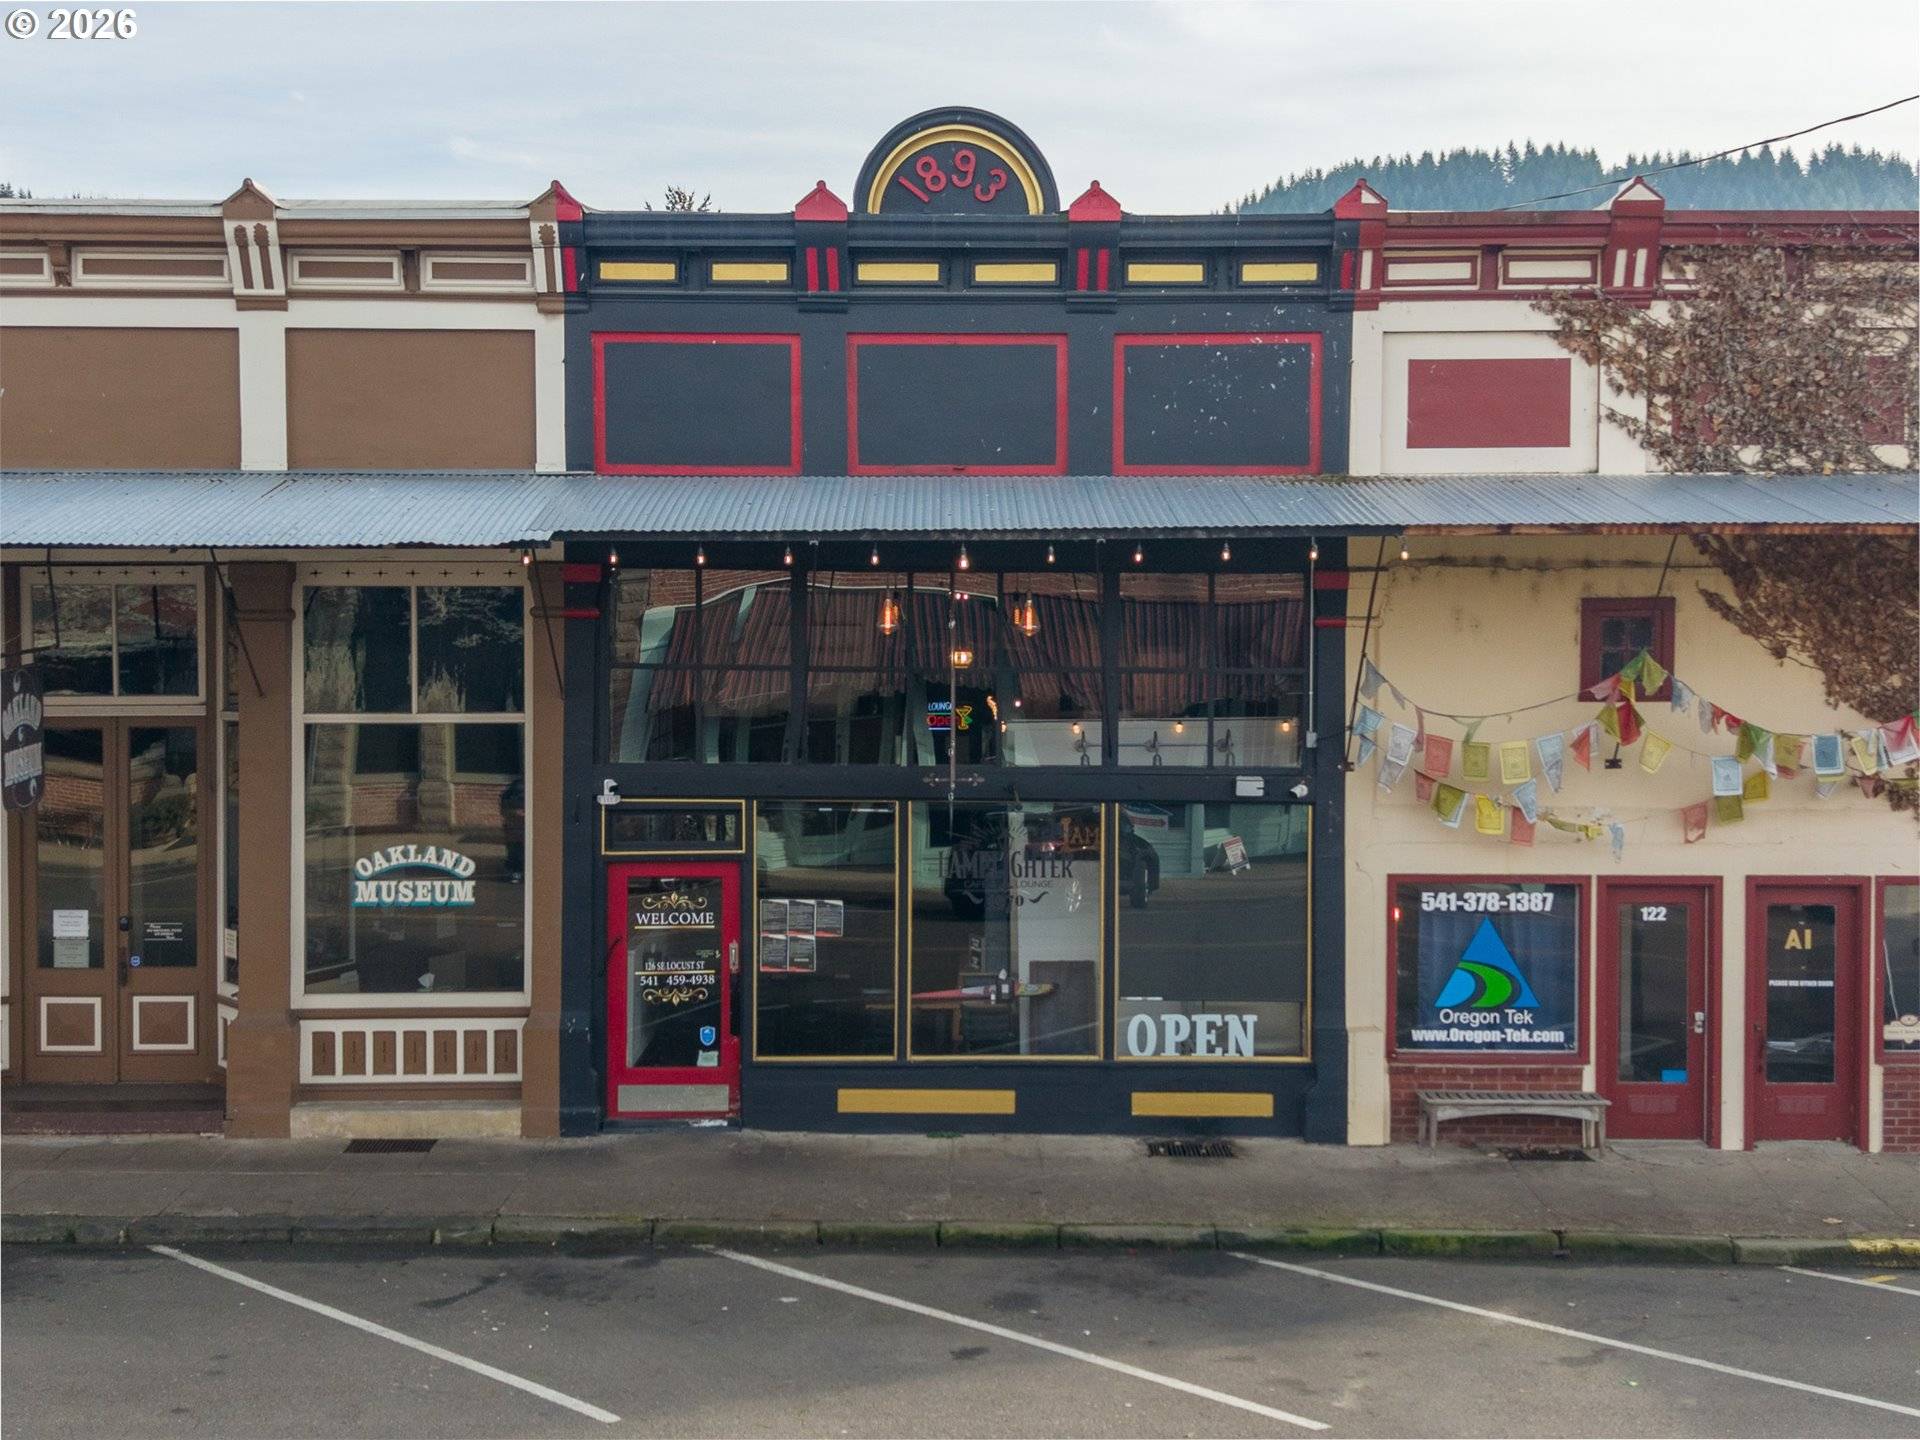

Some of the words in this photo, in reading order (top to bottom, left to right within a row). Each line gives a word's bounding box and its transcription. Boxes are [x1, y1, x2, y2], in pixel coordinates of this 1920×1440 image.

[898, 149, 1008, 203] 1893
[353, 844, 477, 880] OAKLAND
[352, 880, 477, 906] MUSEUM
[1421, 892, 1554, 912] 541-378-1387
[635, 912, 715, 925] WELCOME
[1640, 906, 1667, 921] 122
[1784, 929, 1812, 949] AI
[666, 961, 696, 970] LOCUST
[696, 960, 705, 969] ST
[640, 976, 658, 986] 541
[666, 974, 715, 985] 459-4938
[1440, 1009, 1500, 1027] Oregon
[1504, 1009, 1533, 1024] Tek
[1127, 1013, 1258, 1056] OPEN
[1411, 1028, 1564, 1043] www.Oregon-Tek.com
